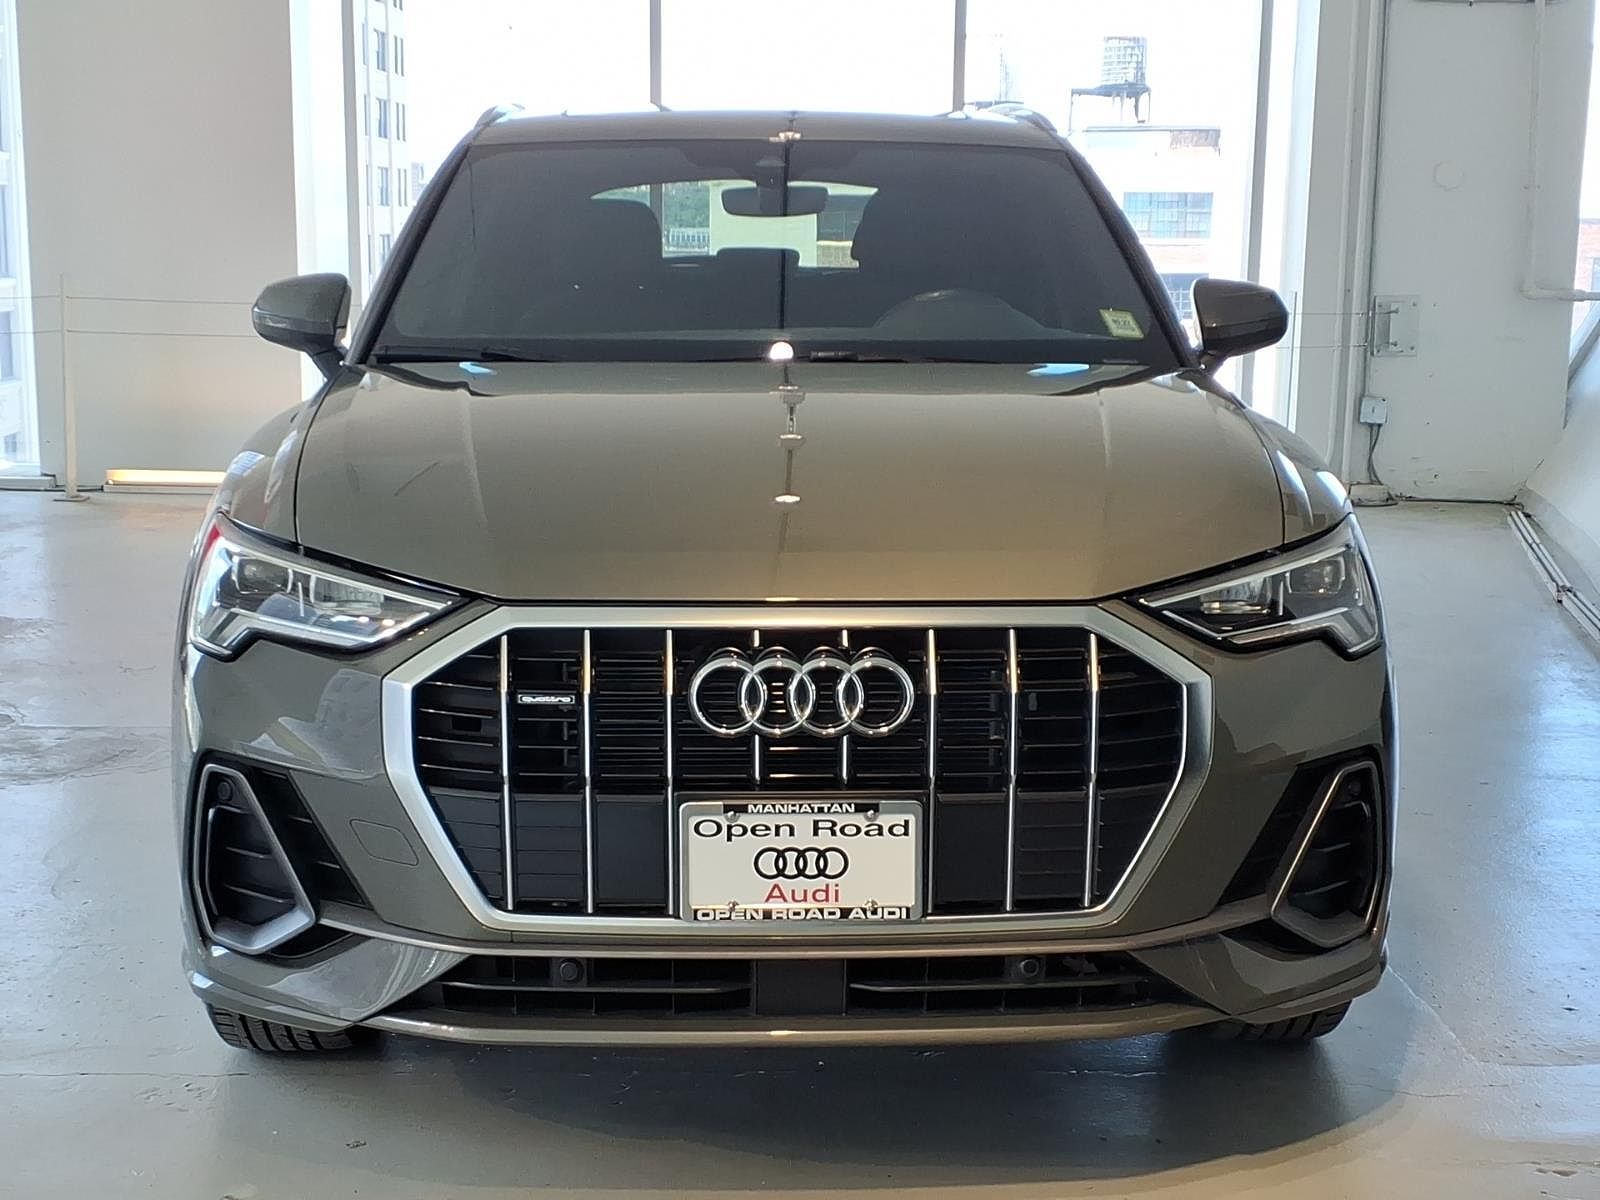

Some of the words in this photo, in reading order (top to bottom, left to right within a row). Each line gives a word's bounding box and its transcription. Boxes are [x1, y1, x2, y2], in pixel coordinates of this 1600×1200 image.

[747, 803, 855, 814] MANHATTAN
[693, 819, 795, 842] Open
[812, 819, 910, 837] Road
[764, 883, 840, 903] Audi
[696, 908, 763, 920] OPEN
[774, 908, 841, 920] ROAD
[845, 907, 907, 919] AUDI
